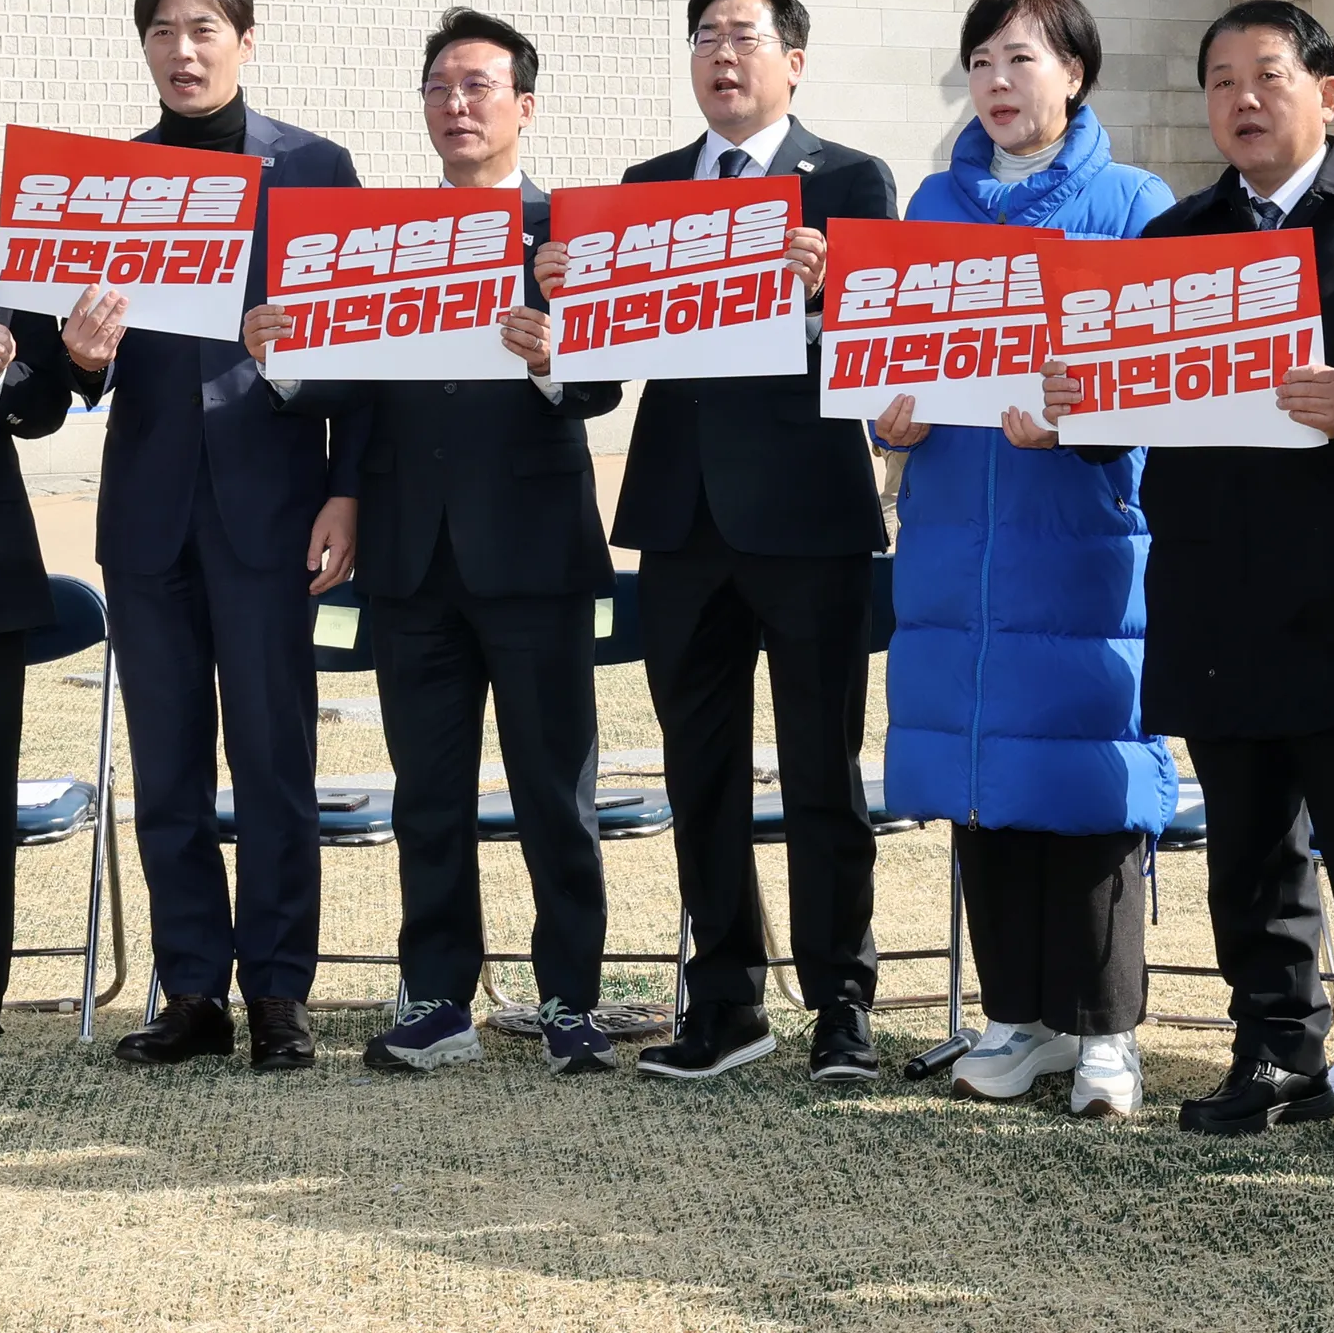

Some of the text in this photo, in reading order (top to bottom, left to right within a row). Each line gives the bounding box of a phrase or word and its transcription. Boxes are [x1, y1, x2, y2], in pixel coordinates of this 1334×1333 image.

[11, 174, 247, 223] 윤석열을
[0, 238, 244, 285] 파면하라!
[280, 210, 510, 287] 윤석열을
[563, 200, 789, 289] 윤석열을
[273, 275, 516, 353] 파면하라!
[557, 268, 795, 355] 파면하라!
[837, 253, 1044, 323] 윤석열을
[1061, 255, 1301, 346] 윤석열을
[828, 324, 1052, 390] 파면하라
